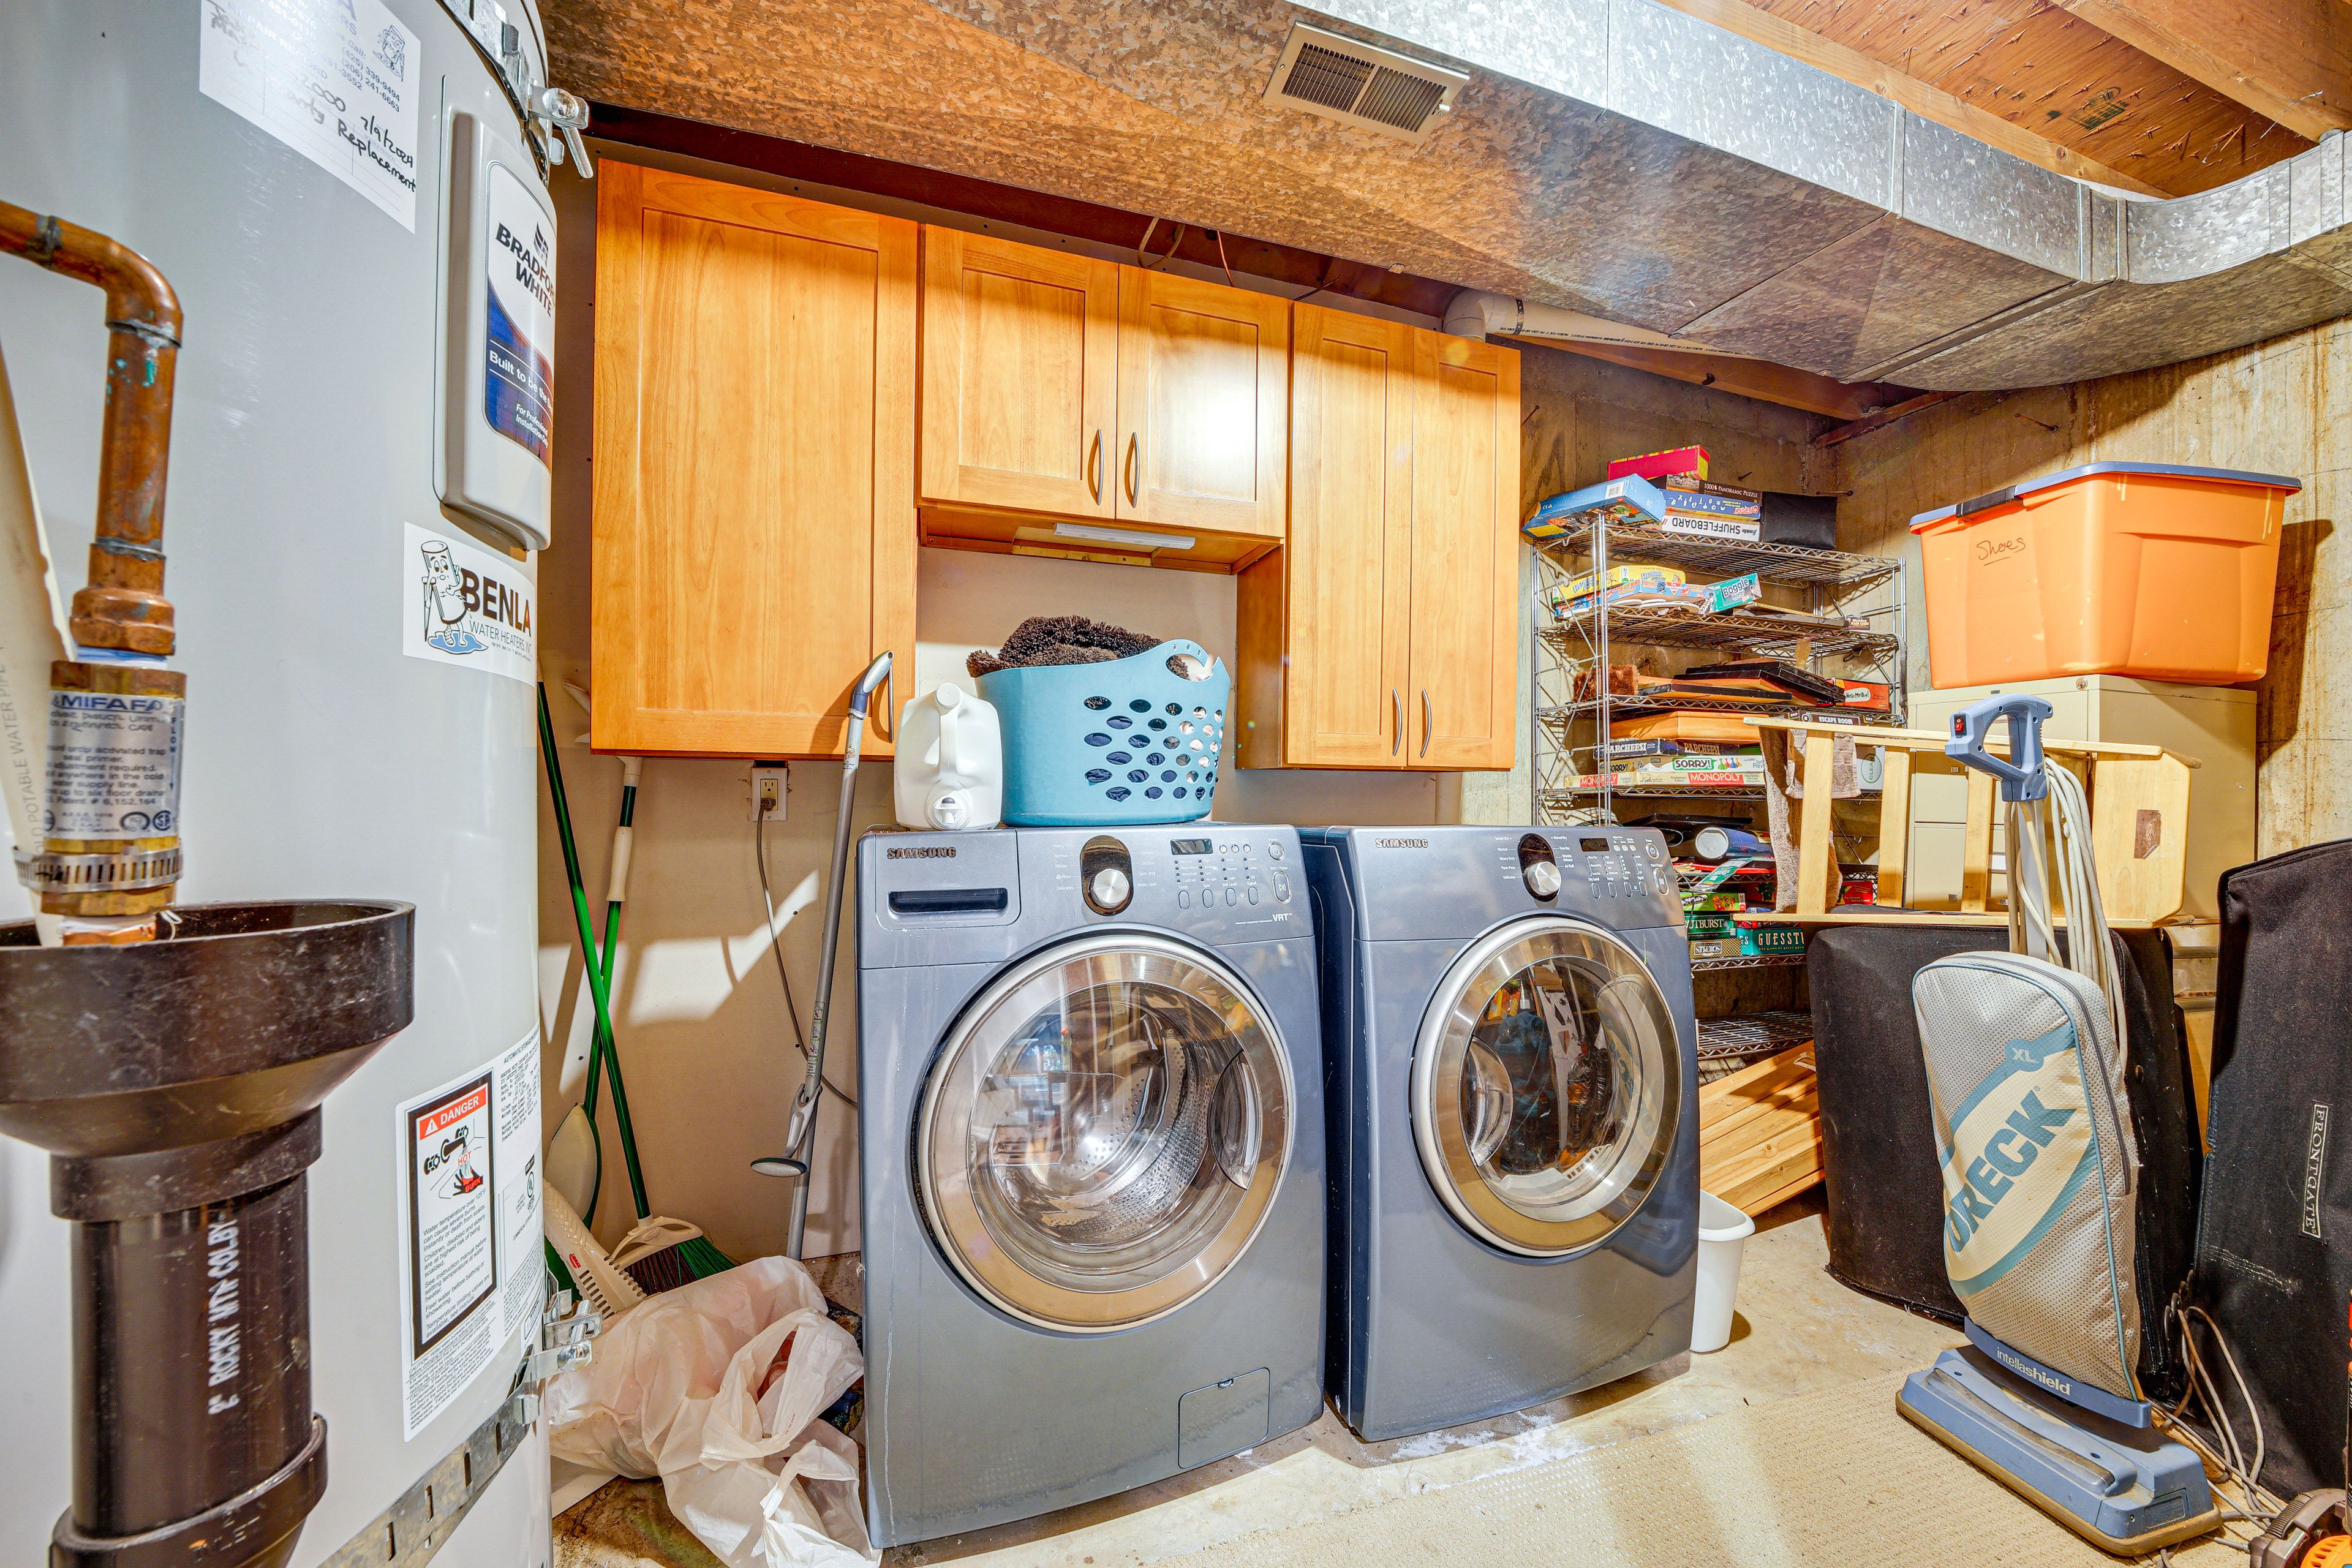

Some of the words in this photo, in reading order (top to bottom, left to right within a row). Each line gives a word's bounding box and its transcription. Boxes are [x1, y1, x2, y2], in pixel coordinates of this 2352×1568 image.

[342, 47, 363, 70] (425)
[366, 67, 400, 102] 339-9494
[342, 58, 363, 80] (206)
[365, 78, 399, 112] 241-6663
[338, 118, 417, 192] Replacement
[516, 259, 552, 318] WHITE
[489, 350, 514, 375] Built
[516, 369, 526, 383] to
[528, 376, 538, 393] be
[539, 387, 548, 404] the
[516, 404, 526, 417] For
[526, 410, 548, 435] Professional
[516, 414, 542, 440] Installation
[1718, 486, 1743, 496] PANORAMIC
[1672, 518, 1741, 535] SHUFFLEBOARD
[1977, 538, 2026, 560] Shoes
[459, 567, 532, 637] BENLA
[1723, 578, 1750, 598] Boggle
[469, 619, 499, 641] WATER
[501, 630, 524, 651] HEATERS
[2, 701, 26, 755] WATER
[1675, 760, 1711, 769] SORRY!
[1684, 742, 1721, 755] PARCHEESI
[13, 758, 39, 823] POTABLE
[1691, 773, 1742, 782] MONOPOLY
[887, 846, 956, 859] SAMSUNG
[1375, 838, 1428, 848] SAMSUNG
[2011, 1047, 2038, 1064] XL
[440, 1095, 480, 1125] DANGER
[458, 1152, 472, 1166] HOT
[1946, 1090, 2077, 1253] ORECK
[2305, 1109, 2325, 1229] FRONTGATE
[465, 1177, 481, 1193] BURN
[423, 1224, 438, 1236] Water
[439, 1205, 466, 1225] temperature
[466, 1198, 475, 1208] over
[476, 1189, 486, 1201] 125°F
[423, 1235, 433, 1244] can
[434, 1226, 448, 1238] cause
[450, 1215, 464, 1227] severe
[464, 1205, 475, 1215] burns
[447, 1229, 465, 1247] disabled
[473, 1213, 486, 1229] elderly
[208, 1219, 239, 1278] COLBY
[424, 1235, 444, 1251] instantly
[451, 1221, 462, 1234] death
[463, 1214, 473, 1224] from
[440, 1245, 456, 1262] highest
[470, 1226, 481, 1238] being
[424, 1277, 435, 1288] See
[436, 1260, 459, 1280] instruction
[460, 1249, 475, 1263] manual
[475, 1237, 487, 1252] before
[424, 1262, 445, 1278] scalded.
[424, 1280, 442, 1295] setting
[442, 1258, 469, 1283] temperature
[473, 1246, 484, 1257] water
[425, 1301, 437, 1312] Feel
[438, 1291, 451, 1303] water
[451, 1278, 466, 1294] before
[466, 1267, 480, 1284] bathing
[425, 1287, 442, 1302] heater.
[426, 1306, 456, 1330] Temperature
[456, 1292, 471, 1308] limiting
[471, 1281, 483, 1295] valves
[459, 1296, 475, 1313] manual.
[426, 1298, 452, 1319] showering.
[208, 1323, 241, 1387] ROCKY
[1997, 1347, 2071, 1396] intellashield
